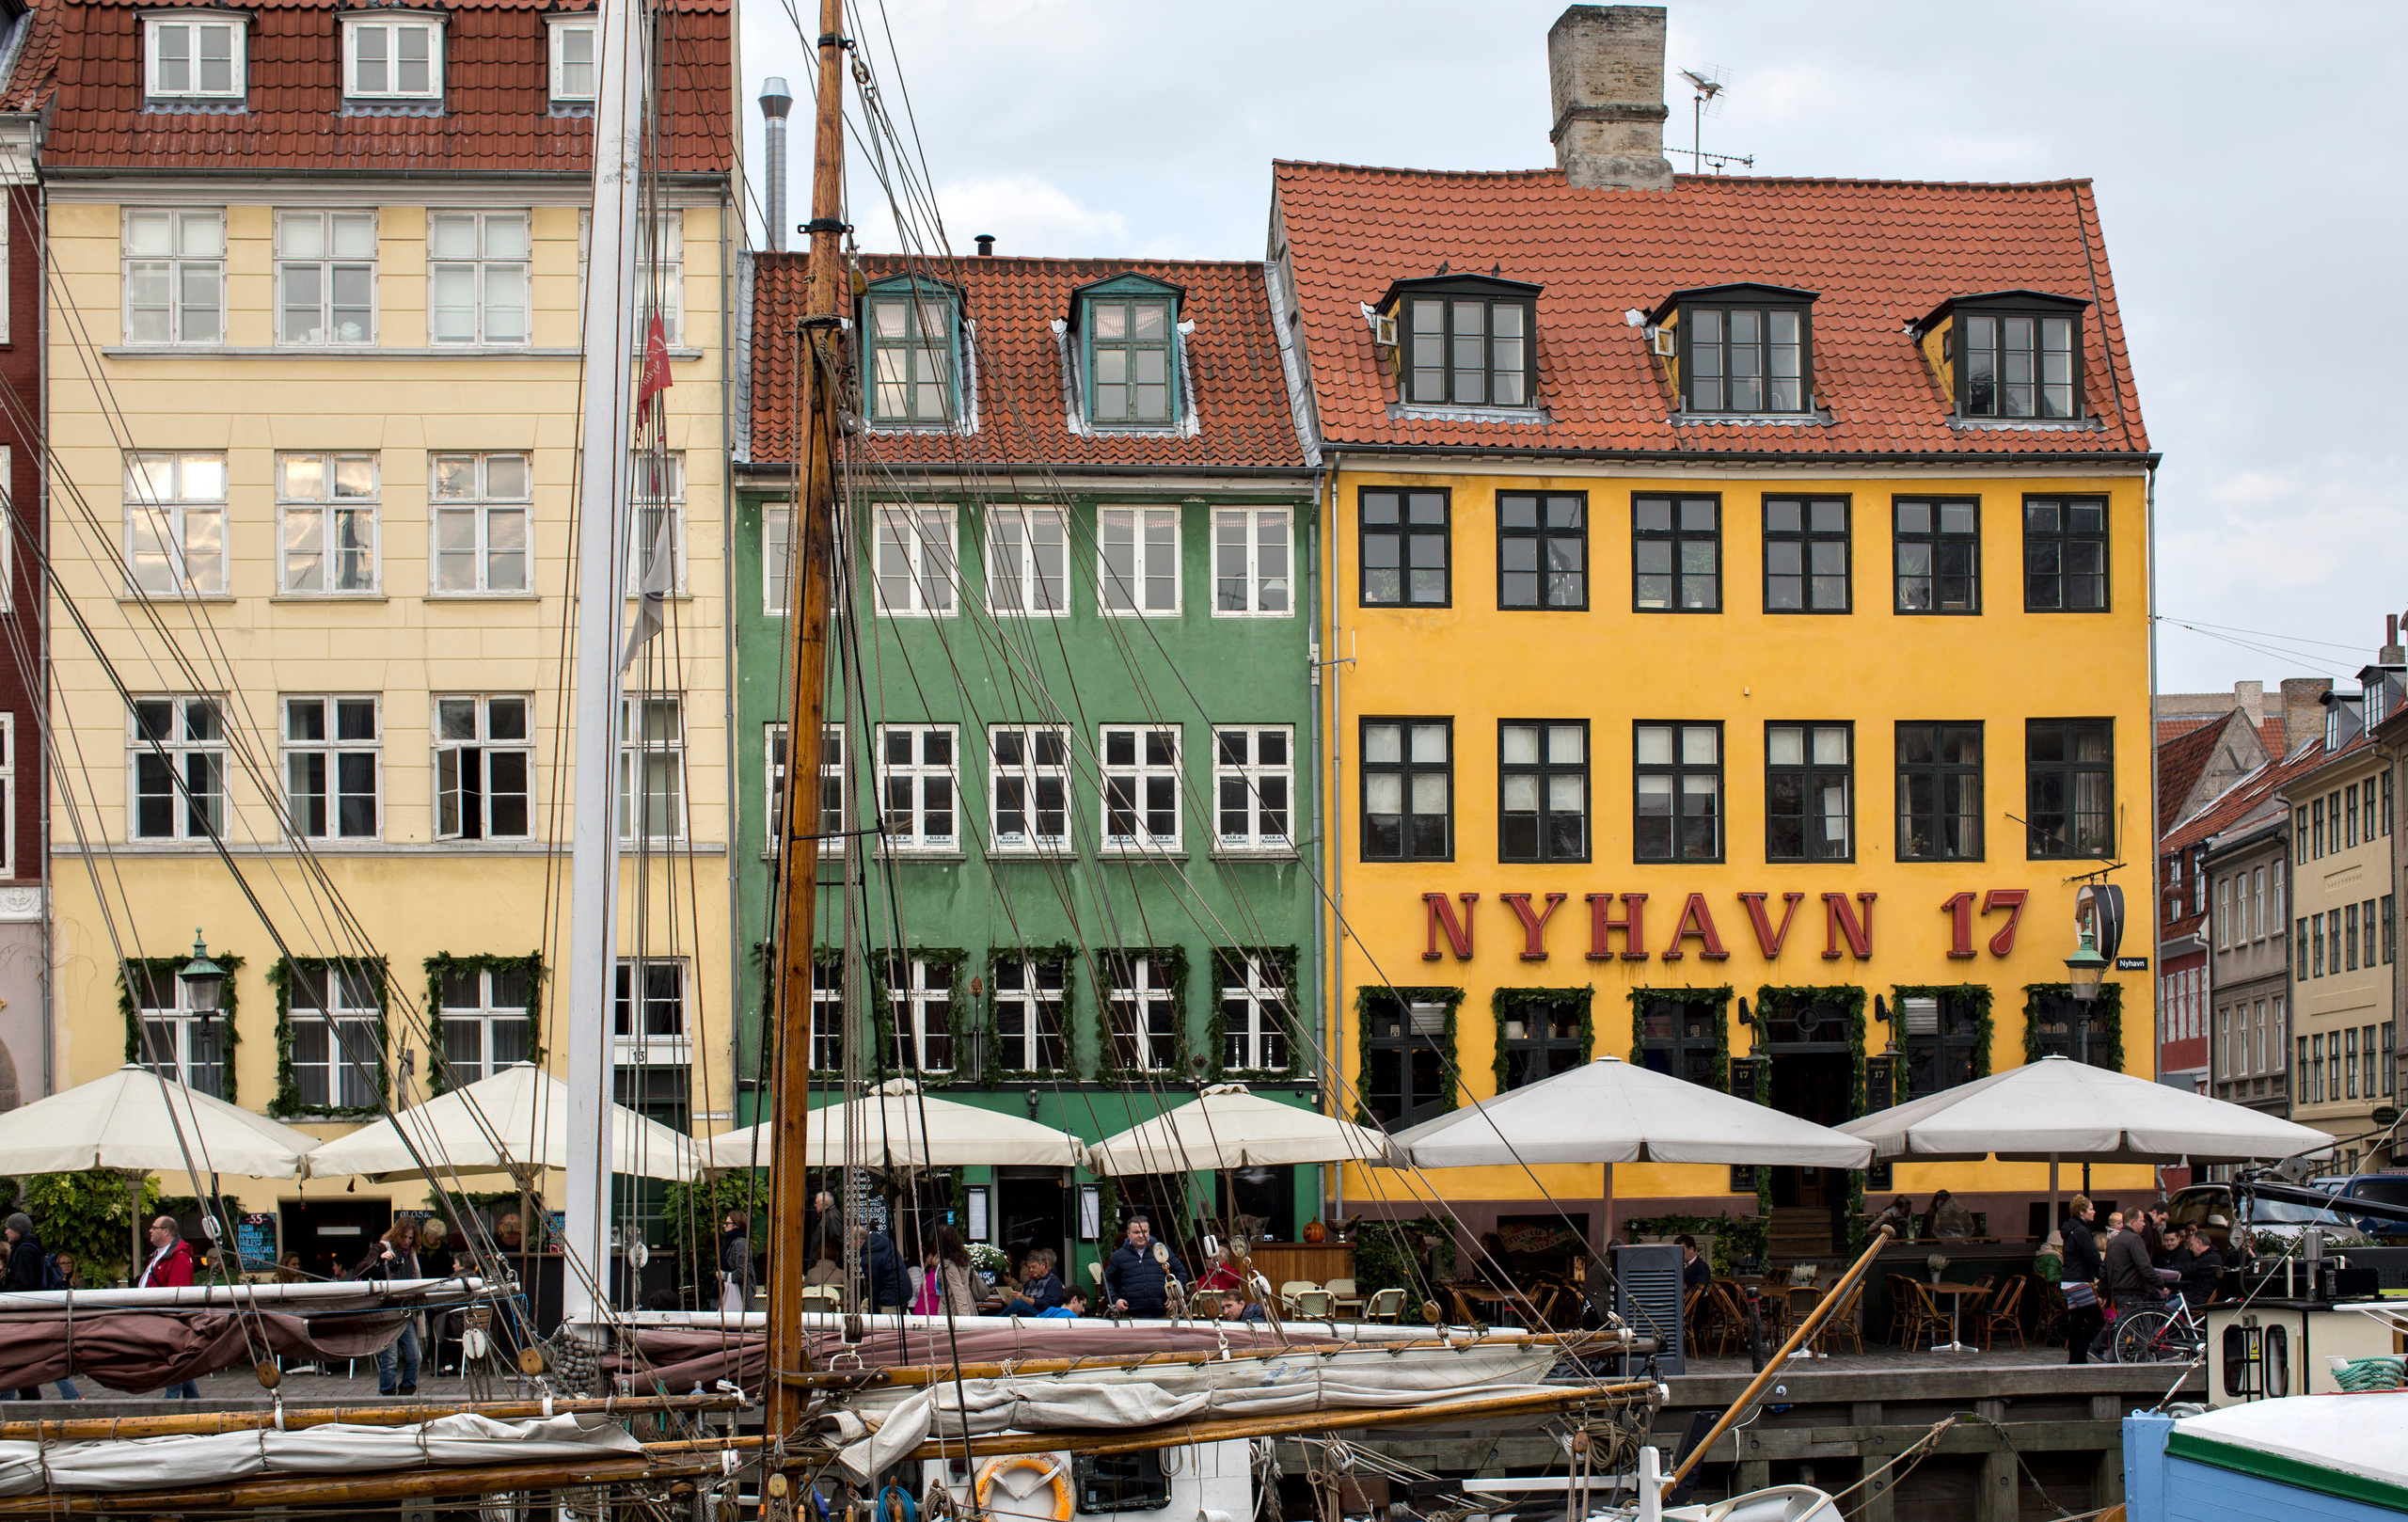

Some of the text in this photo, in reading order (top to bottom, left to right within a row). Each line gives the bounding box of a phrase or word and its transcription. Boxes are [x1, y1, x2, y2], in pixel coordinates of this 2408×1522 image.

[1421, 889, 2029, 961] NYHAVN 17
[2119, 959, 2145, 968] Nyhavn
[633, 1051, 644, 1061] 13
[1738, 1070, 1750, 1079] 17
[1874, 1070, 1884, 1079] 17
